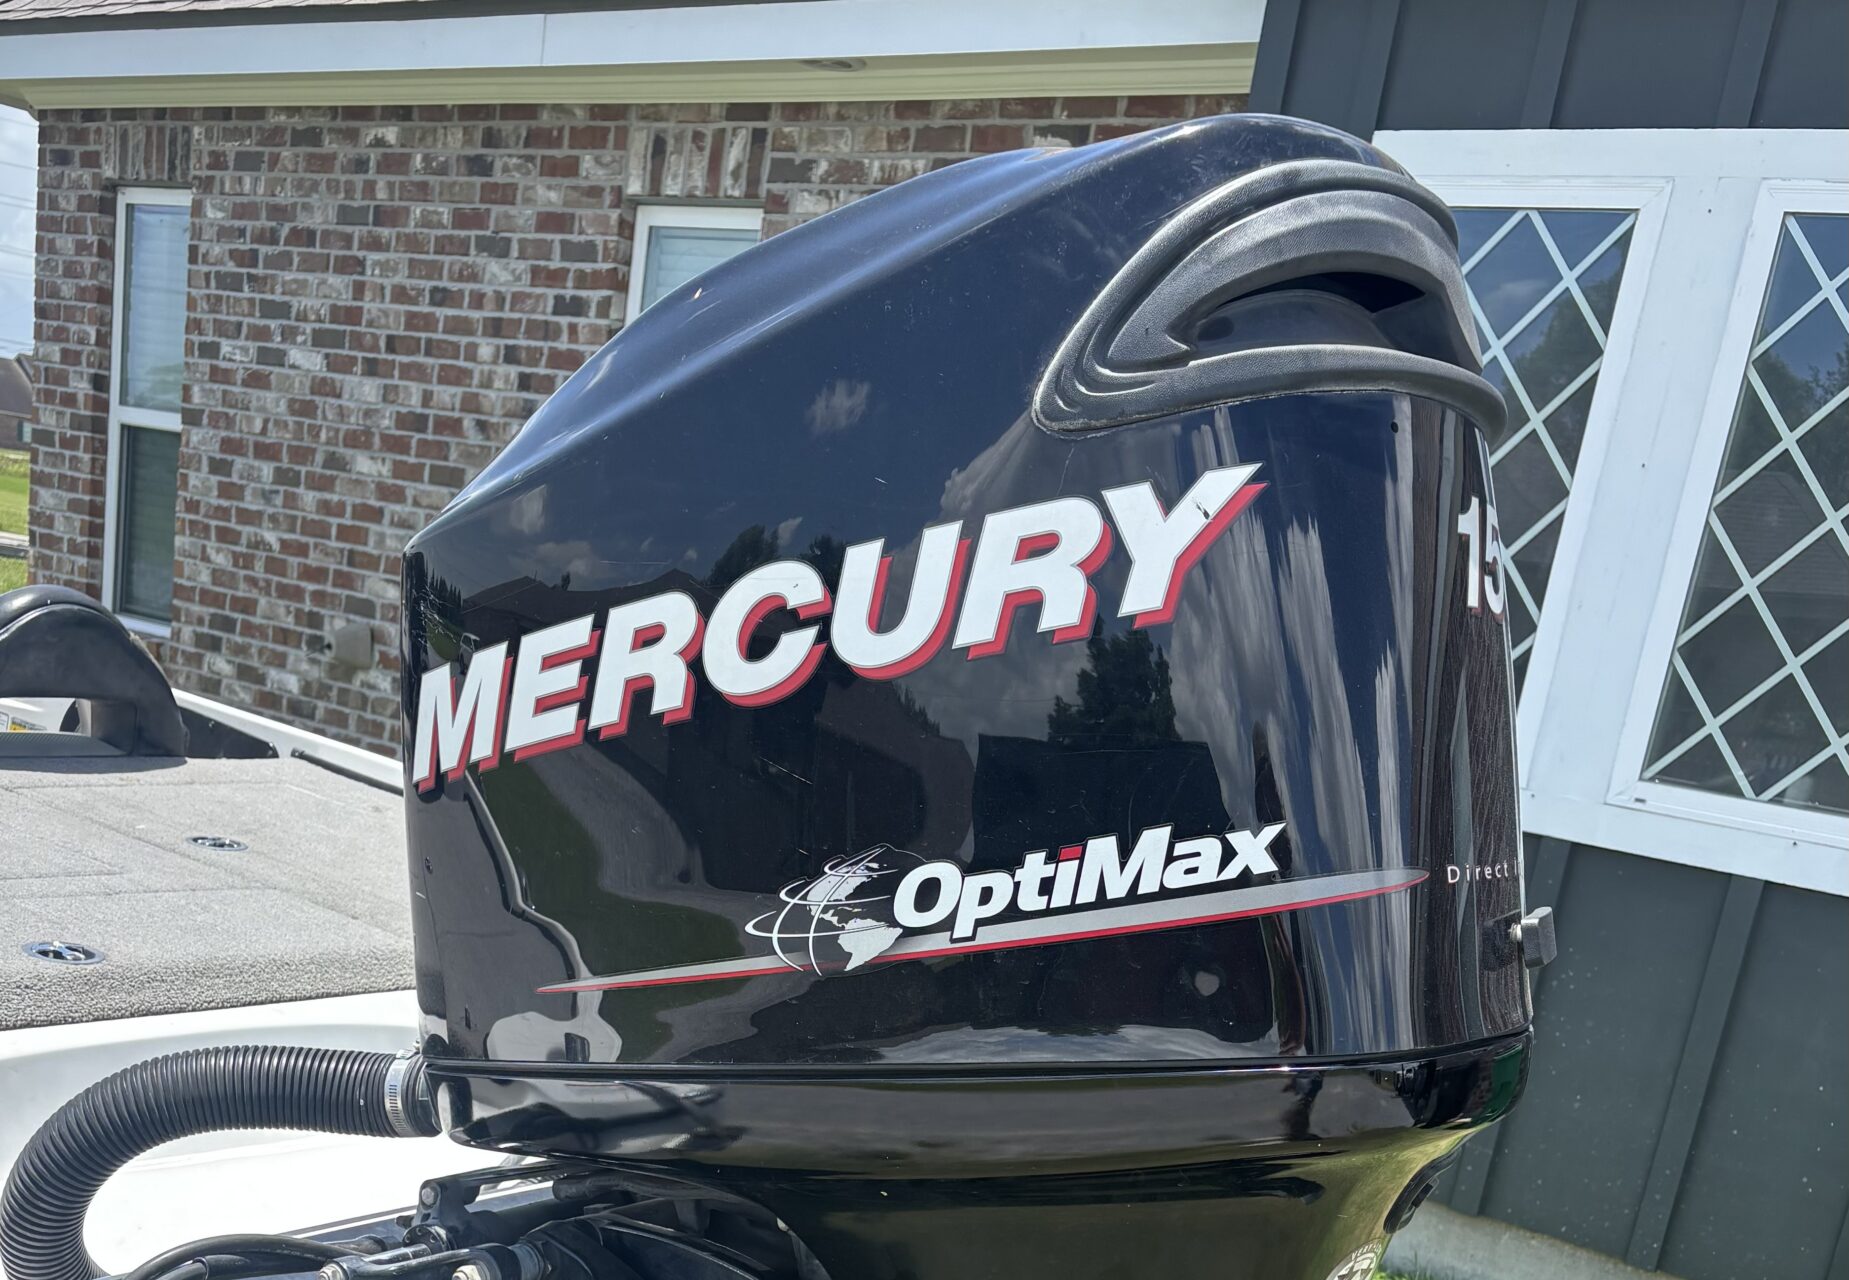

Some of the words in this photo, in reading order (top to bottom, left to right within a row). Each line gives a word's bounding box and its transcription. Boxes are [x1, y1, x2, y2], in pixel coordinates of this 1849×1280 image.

[414, 463, 1270, 791] MERCURY
[893, 822, 1286, 938] OptiMax
[1447, 860, 1508, 884] Direct
